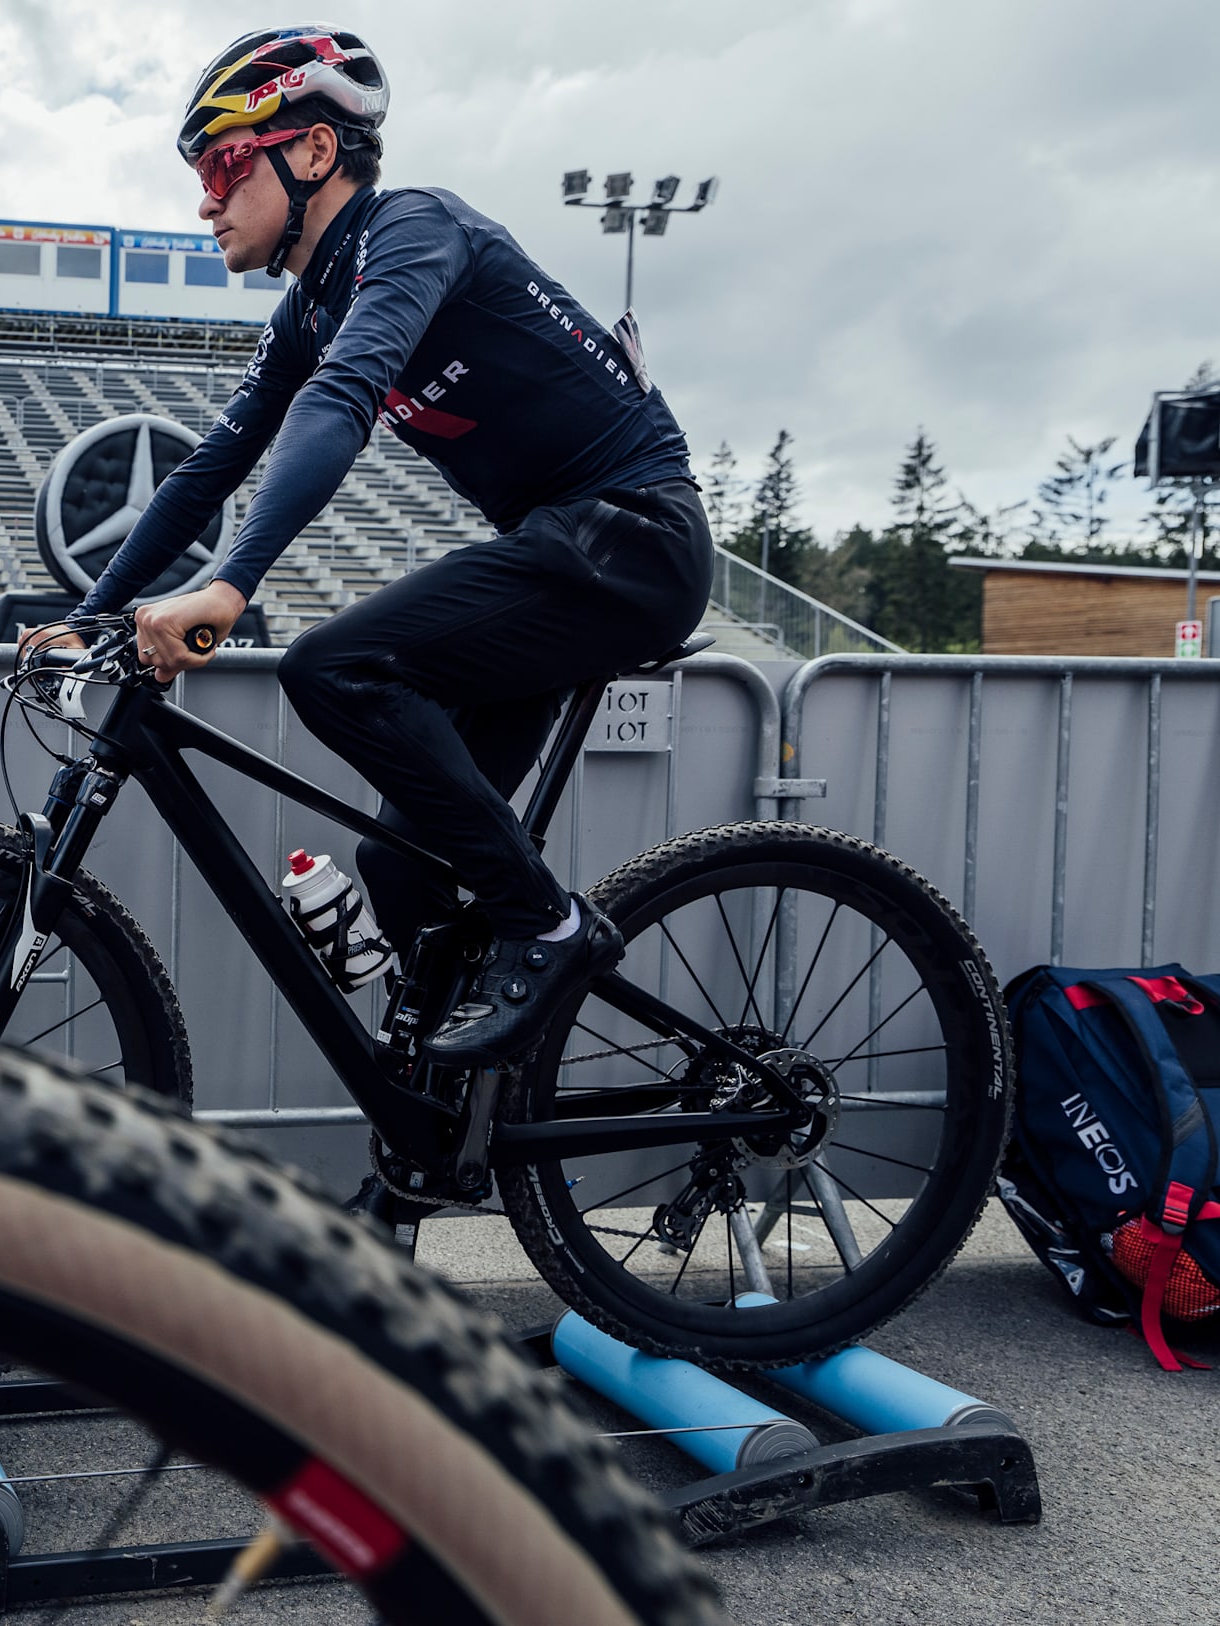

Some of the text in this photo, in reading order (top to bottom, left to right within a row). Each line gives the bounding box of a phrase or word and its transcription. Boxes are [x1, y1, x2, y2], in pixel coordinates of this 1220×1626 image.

[526, 280, 628, 386] GRENADIER
[963, 959, 1005, 1101] CONTINENTAL
[1060, 1092, 1138, 1195] INEOS
